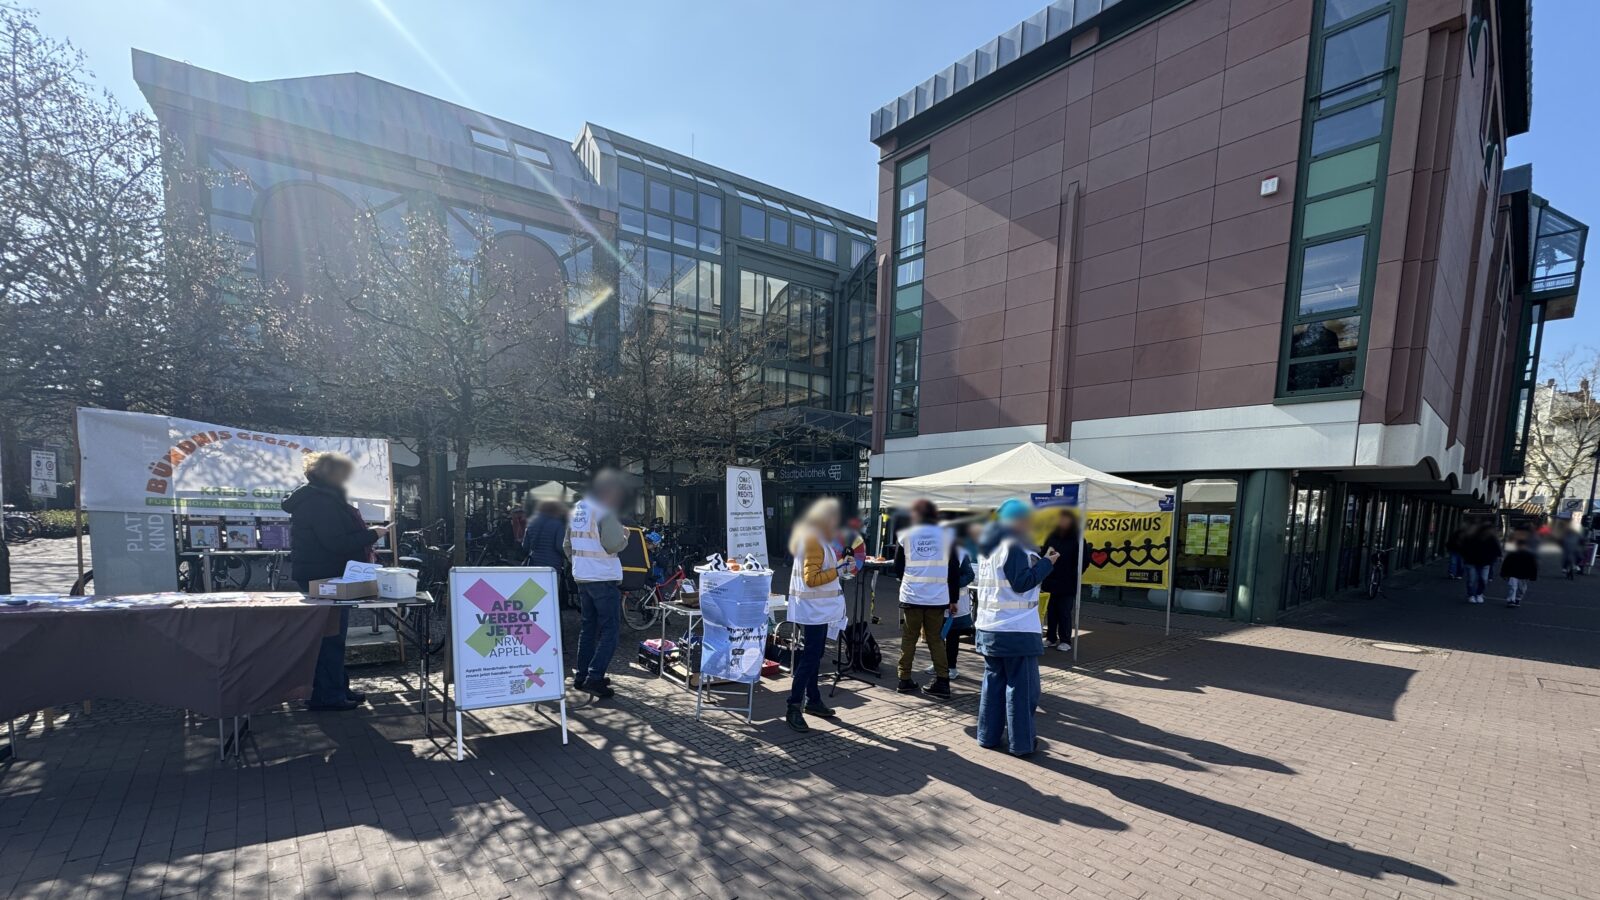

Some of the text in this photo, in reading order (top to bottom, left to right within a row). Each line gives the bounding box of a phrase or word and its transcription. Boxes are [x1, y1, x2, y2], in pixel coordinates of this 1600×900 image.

[146, 431, 232, 494] BÜNDNIS
[236, 431, 300, 450] GEGEN
[780, 467, 826, 479] Stadtbibliothek
[200, 486, 247, 498] KREIS
[1086, 517, 1161, 531] RASSISMUS
[491, 600, 524, 611] AFD
[475, 611, 540, 624] VERBOT
[486, 623, 533, 636] JETZT
[495, 636, 524, 647] NRW
[489, 646, 531, 658] APPELL
